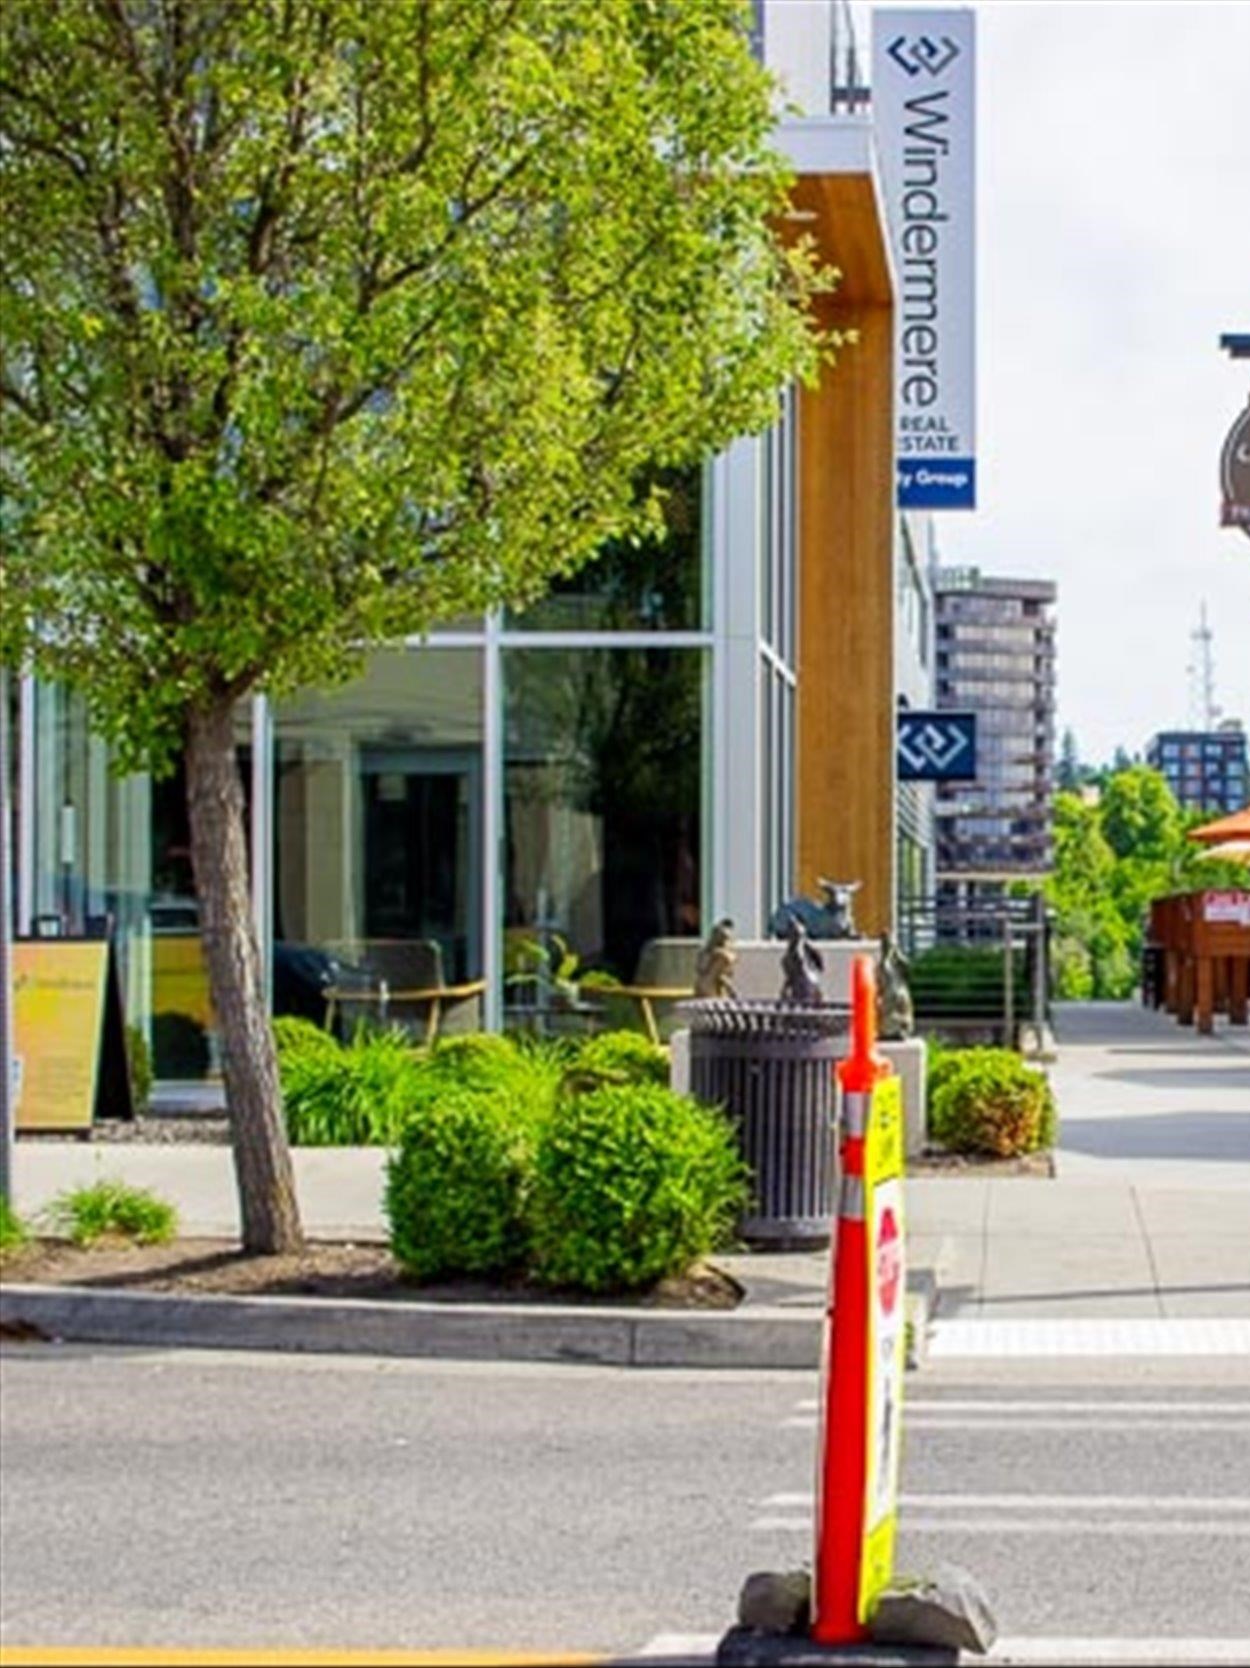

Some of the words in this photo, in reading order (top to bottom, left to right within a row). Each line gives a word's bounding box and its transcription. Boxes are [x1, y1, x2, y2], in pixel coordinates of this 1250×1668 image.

[902, 90, 949, 407] Windermere
[900, 415, 950, 432] REAL
[916, 468, 968, 489] Group
